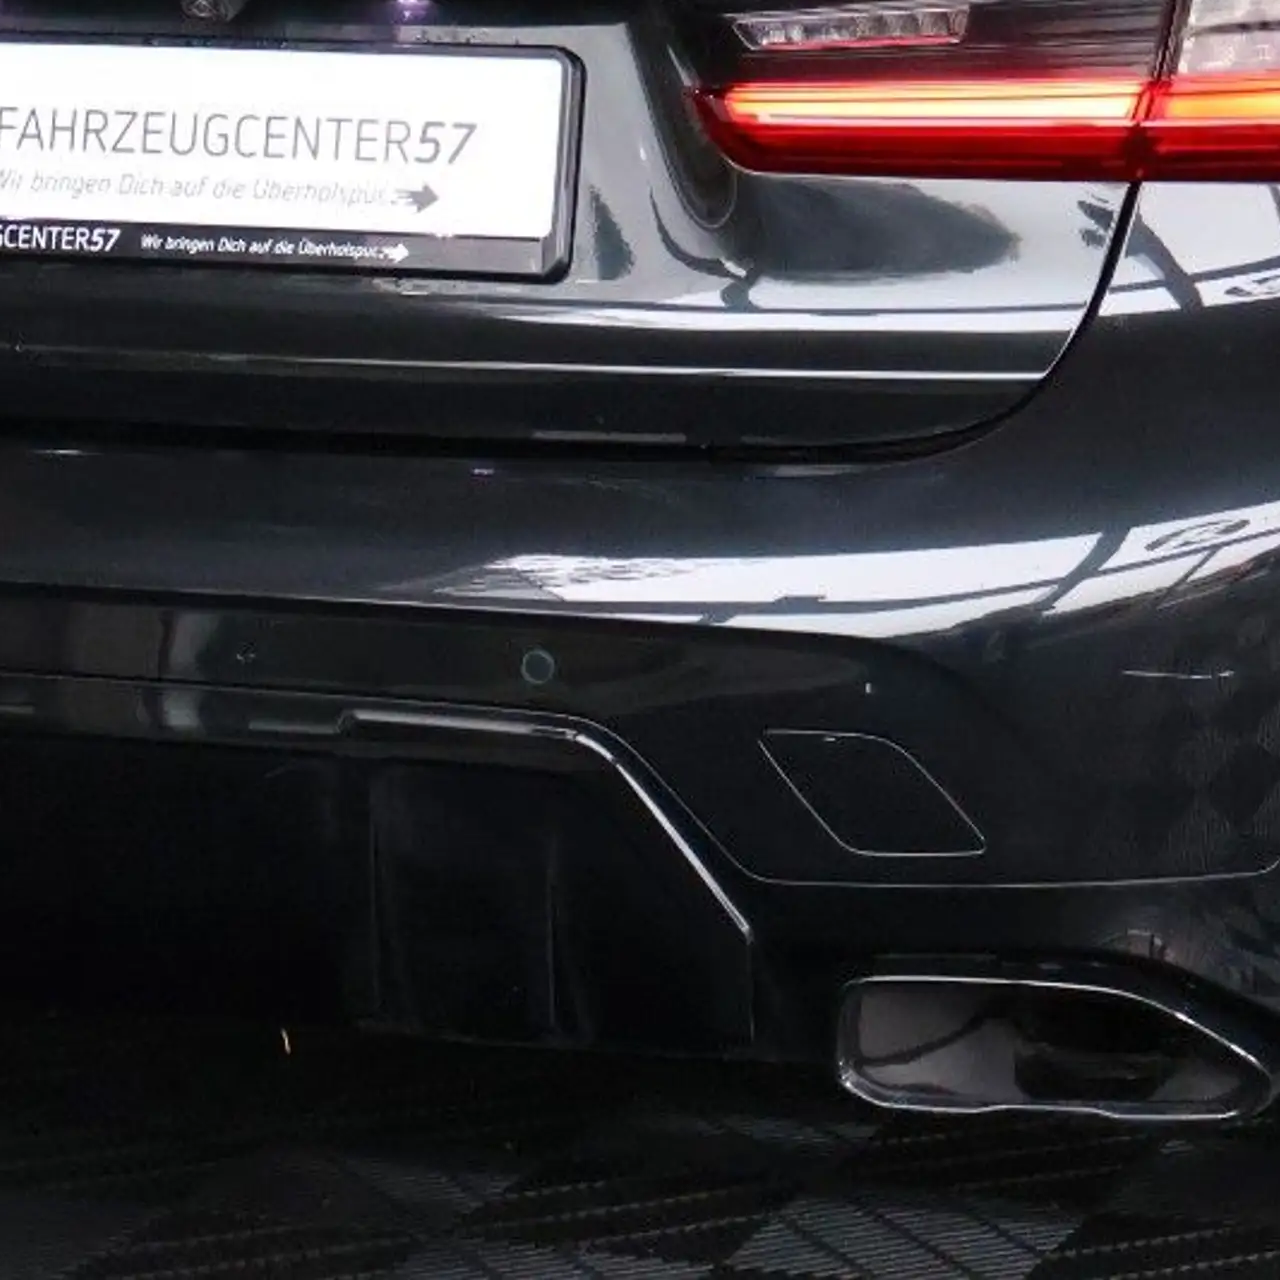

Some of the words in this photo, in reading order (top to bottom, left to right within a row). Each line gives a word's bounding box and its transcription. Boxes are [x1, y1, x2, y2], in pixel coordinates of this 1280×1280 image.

[30, 172, 112, 199] bringen
[118, 173, 167, 198] Dich
[170, 177, 209, 200] auf
[212, 179, 247, 200] die
[141, 232, 162, 250] Wir
[164, 234, 215, 255] bringen
[217, 235, 246, 253] Dich
[248, 238, 272, 255] auf
[273, 239, 295, 257] die
